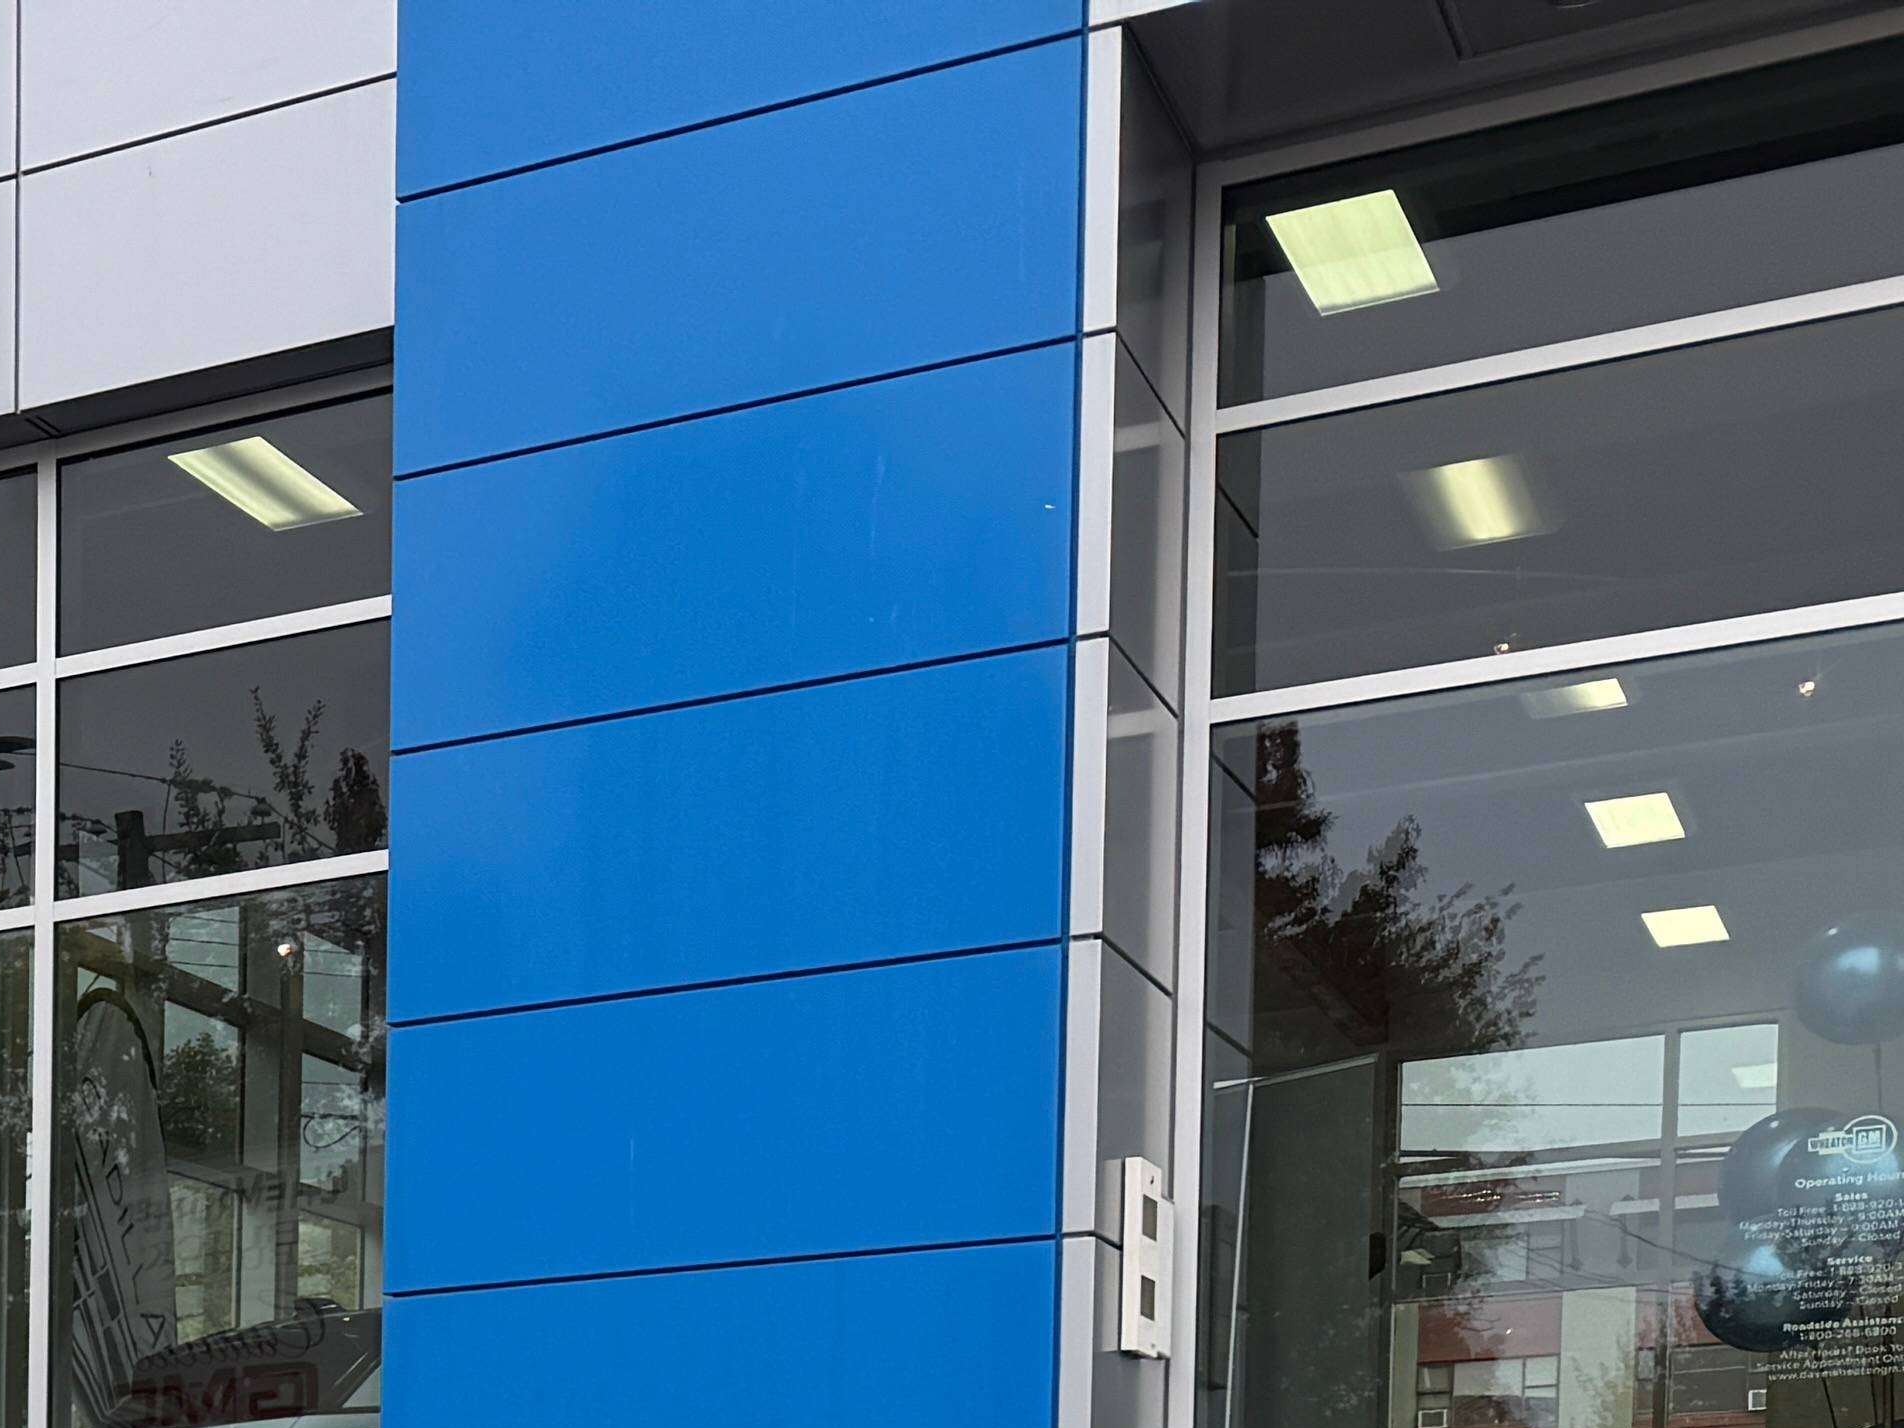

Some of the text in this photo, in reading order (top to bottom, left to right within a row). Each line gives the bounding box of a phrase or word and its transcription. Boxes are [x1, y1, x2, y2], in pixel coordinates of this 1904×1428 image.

[1809, 1130, 1881, 1149] WHEATON GM
[1794, 1169, 1904, 1190] Operating Hour
[1835, 1192, 1868, 1202] Sales
[1801, 1230, 1900, 1248] Sunday Closed
[1827, 1255, 1873, 1266] Service
[1783, 1320, 1840, 1332] Roadside
